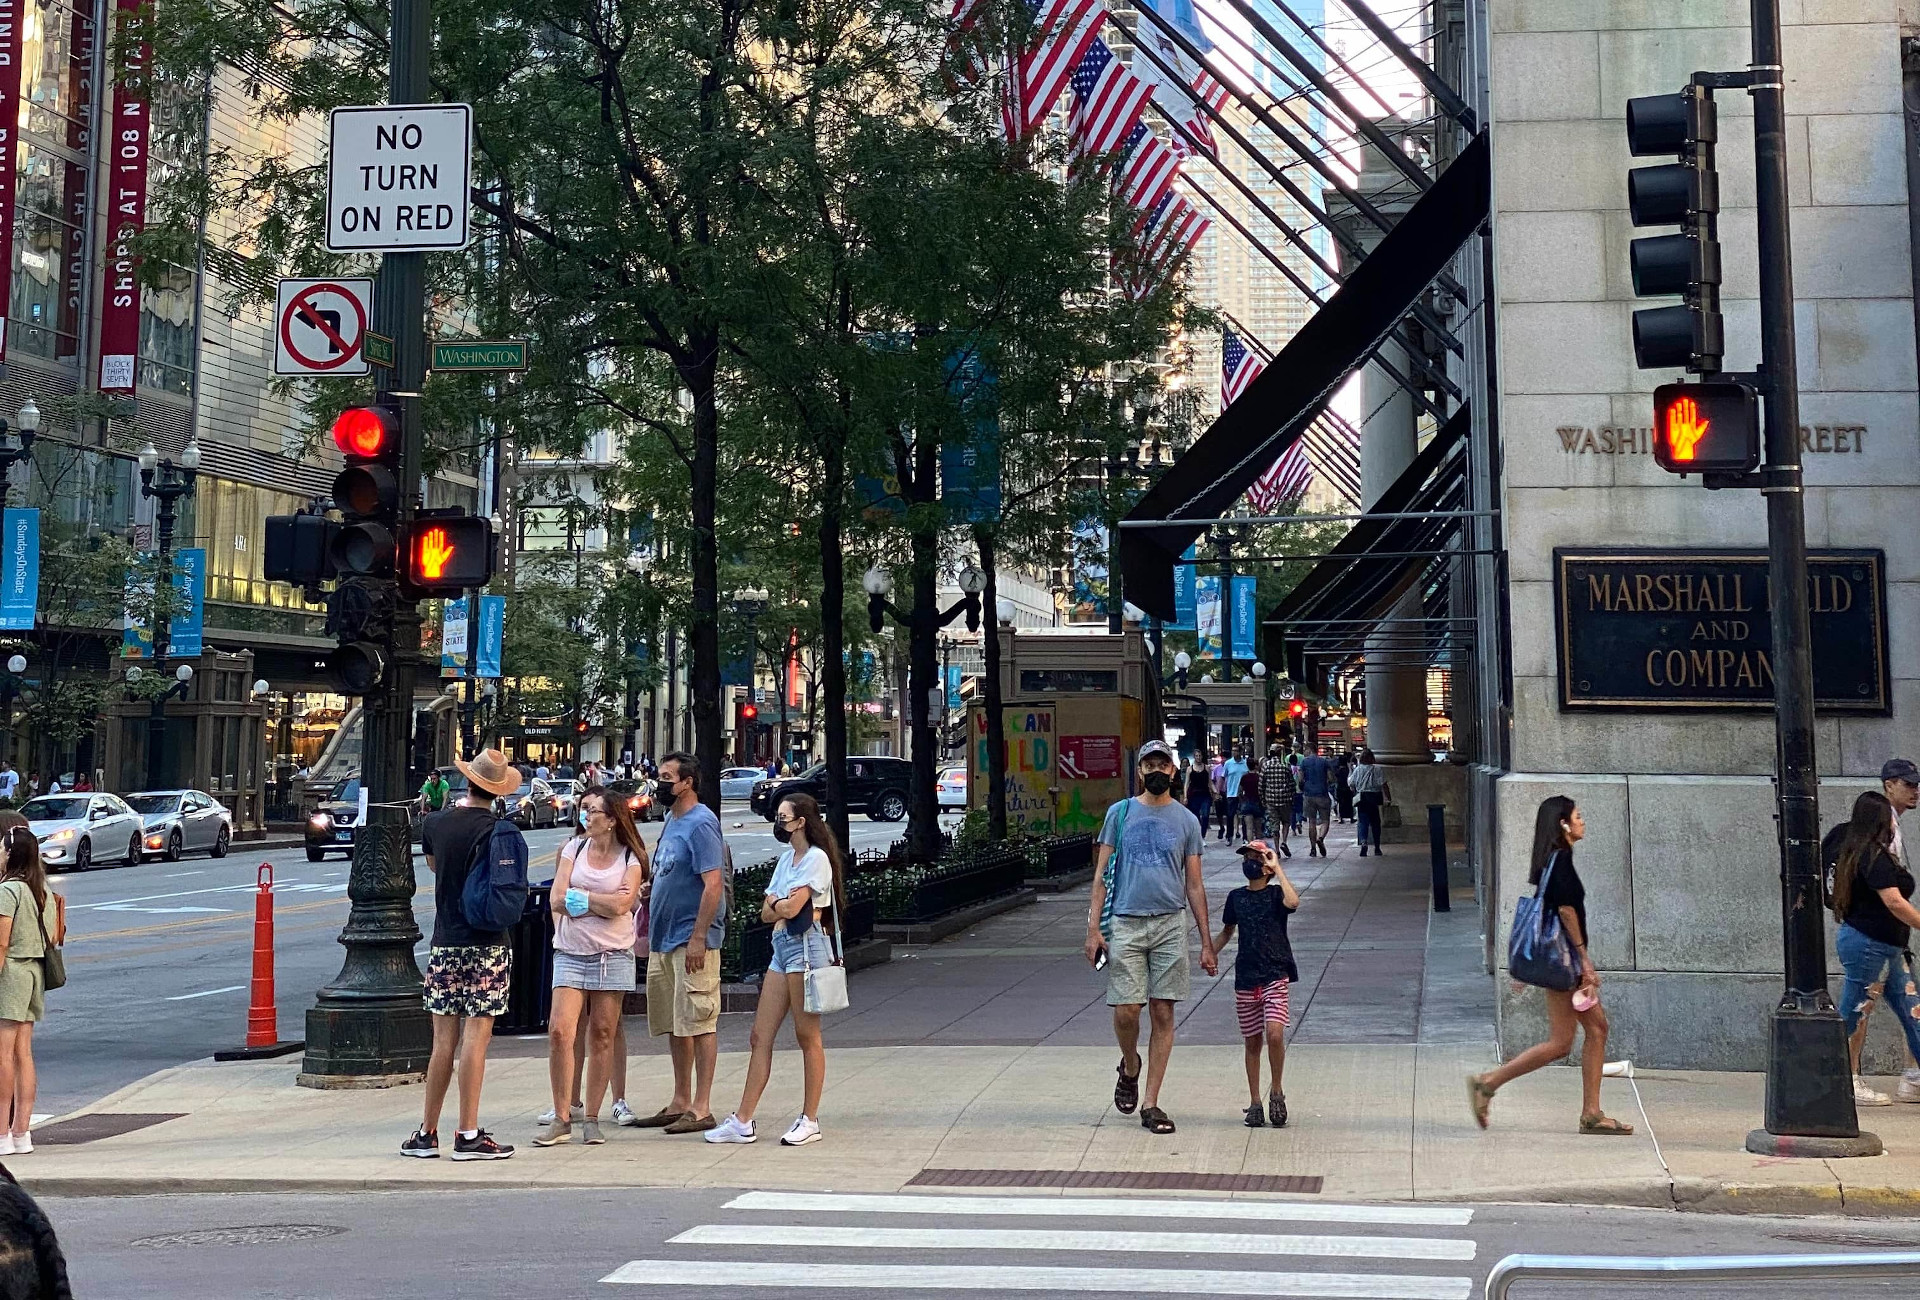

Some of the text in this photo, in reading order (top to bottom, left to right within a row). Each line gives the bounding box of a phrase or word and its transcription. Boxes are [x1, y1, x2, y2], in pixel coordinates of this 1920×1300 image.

[123, 103, 141, 116] N
[376, 123, 423, 150] NO
[121, 129, 140, 173] 108
[359, 163, 438, 191] TURN
[119, 188, 138, 215] AT
[341, 204, 454, 233] ON RED
[106, 360, 131, 368] BLOCK
[439, 349, 519, 364] WASHINGTON
[106, 368, 130, 376] THIRTY
[106, 375, 129, 383] SEVEN
[1556, 425, 1868, 455] WASHI REET
[15, 518, 28, 595] #SundaysOnState
[1174, 566, 1185, 597] OnState
[1588, 573, 1753, 612] MARSHALL
[445, 635, 465, 646] STATE
[1690, 620, 1750, 641] AND
[1646, 649, 1776, 688] COMPAN
[1011, 712, 1051, 733] CAN
[978, 737, 1049, 773] BILD
